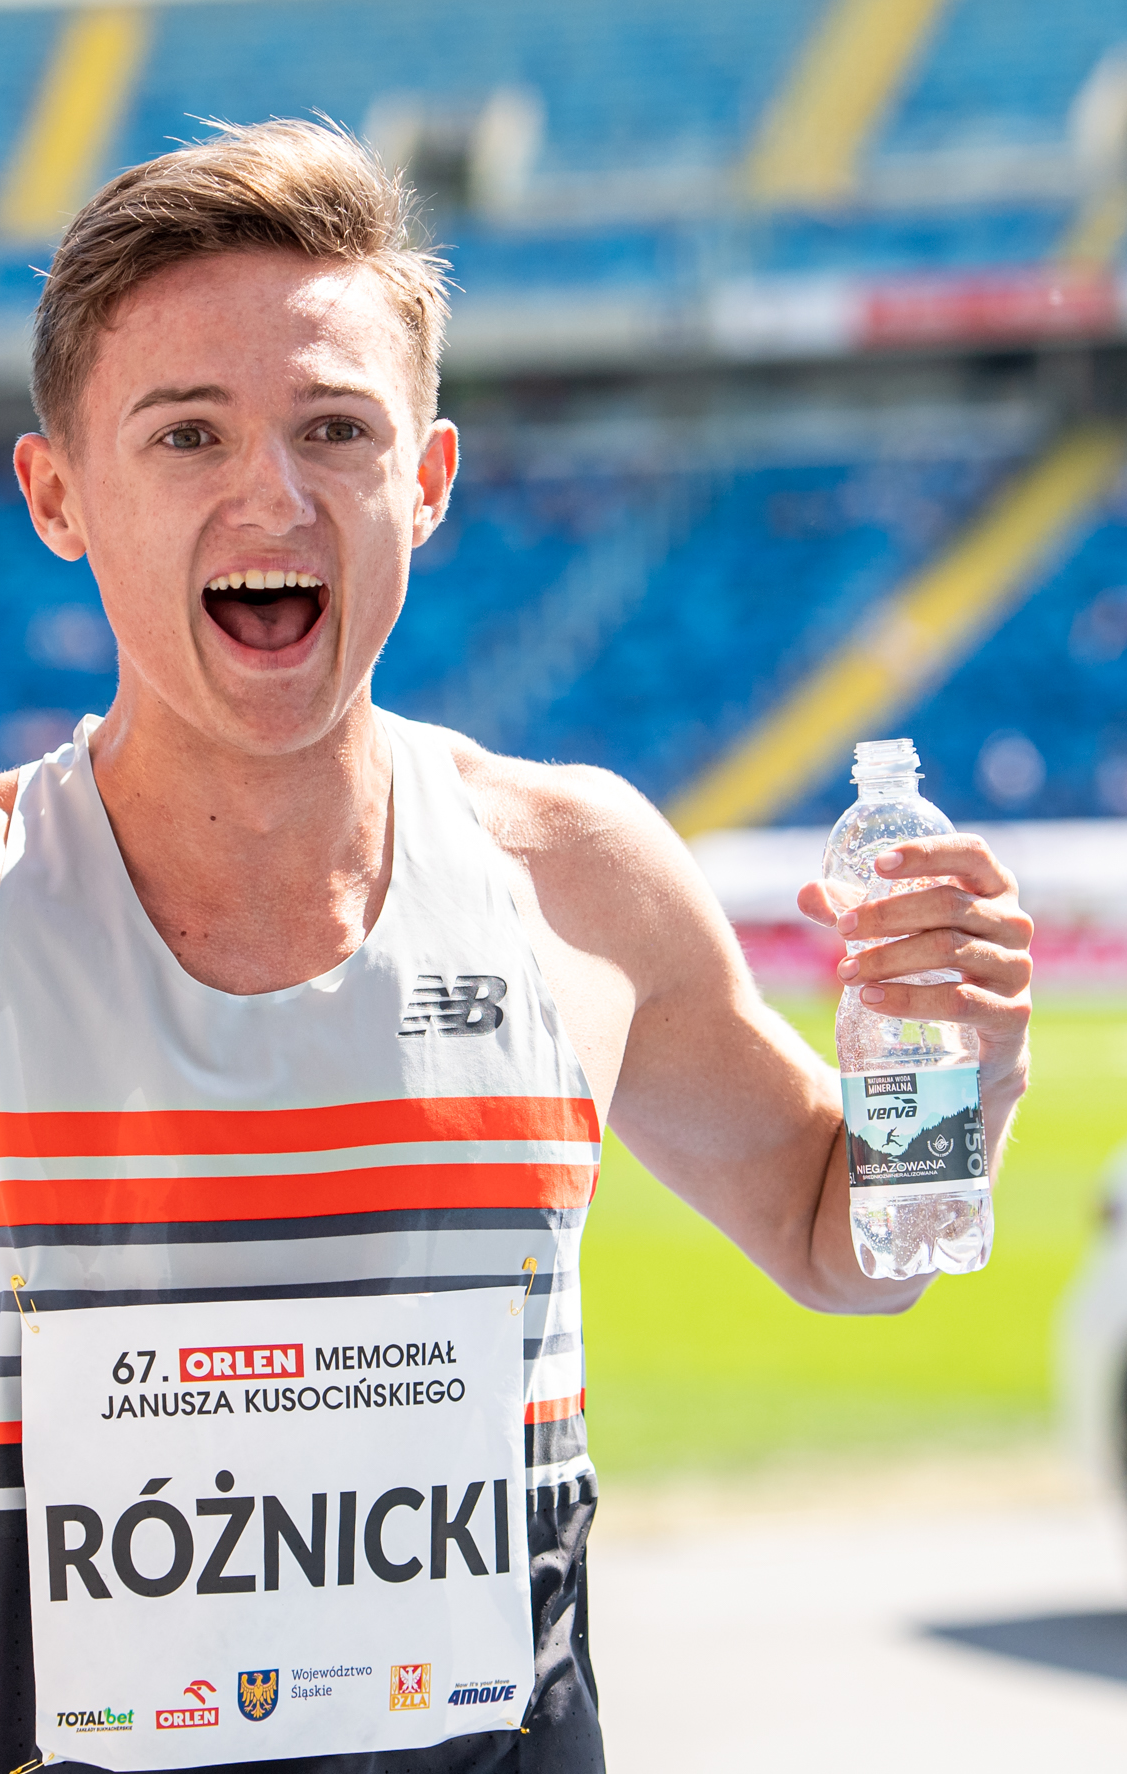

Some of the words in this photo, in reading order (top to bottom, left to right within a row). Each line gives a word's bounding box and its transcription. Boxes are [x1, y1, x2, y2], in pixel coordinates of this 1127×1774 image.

[868, 1076, 894, 1084] NATURALNA
[868, 1082, 913, 1094] MINERALNA
[867, 1104, 918, 1121] verva
[856, 1159, 946, 1175] NIEGAZOWANA
[112, 1351, 170, 1385] 67.
[186, 1348, 297, 1378] ORLEN
[315, 1340, 457, 1372] MEMORIAŁ
[101, 1390, 235, 1420] JANUSZA
[244, 1378, 466, 1413] KUSOCIŃSKIEGO
[45, 1469, 511, 1603] RÓŻNICKI
[291, 1664, 373, 1682] Województwo
[291, 1684, 333, 1700] Śląskie
[391, 1694, 428, 1709] PZLA
[158, 1710, 216, 1727] ORLEN
